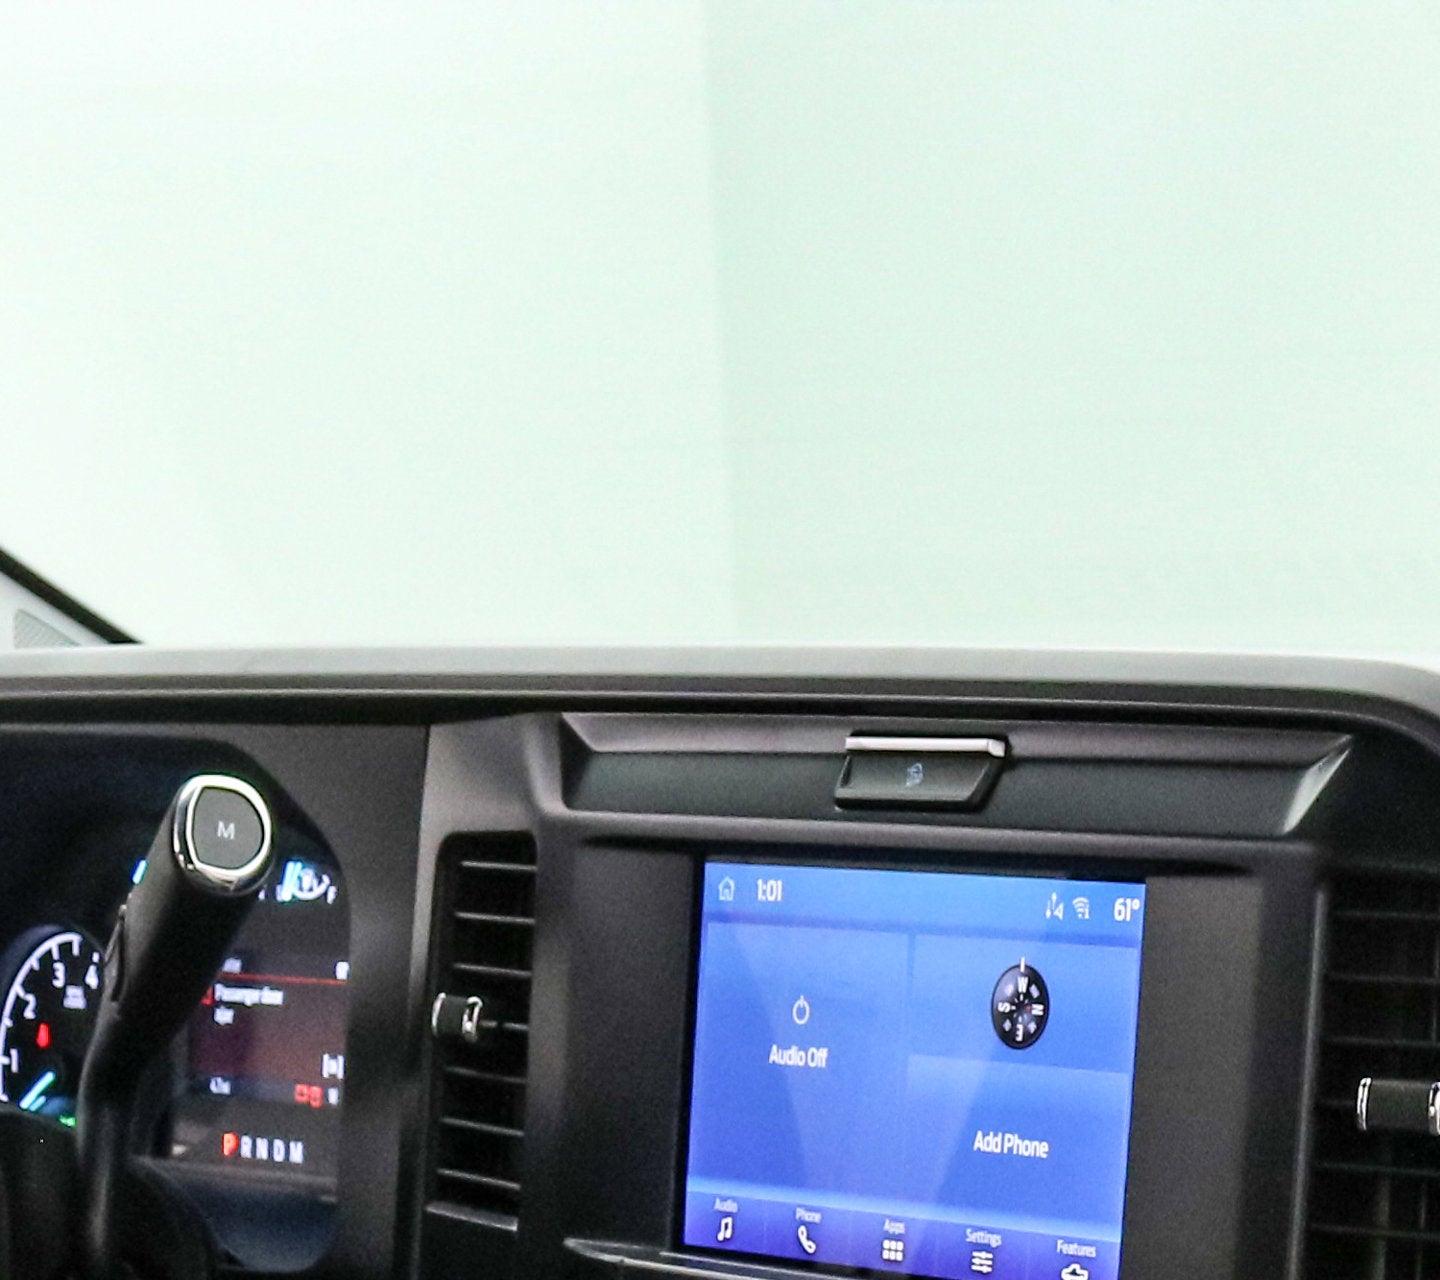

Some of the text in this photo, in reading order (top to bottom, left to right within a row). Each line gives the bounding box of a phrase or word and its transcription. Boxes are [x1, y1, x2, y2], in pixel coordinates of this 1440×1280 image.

[217, 821, 236, 840] M
[757, 879, 783, 902] 1:01
[1113, 897, 1141, 922] 61°
[51, 961, 66, 989] 3
[84, 964, 100, 990] 4
[1017, 976, 1029, 994] W
[23, 993, 37, 1020] 2
[10, 1048, 19, 1073] 1
[768, 1044, 829, 1069] Audio Off
[221, 1132, 239, 1157] P
[240, 1135, 253, 1159] R
[272, 1138, 286, 1163] D
[973, 1130, 1050, 1159] Add Phone
[965, 1228, 1002, 1248] Settings
[1057, 1239, 1097, 1258] Features
